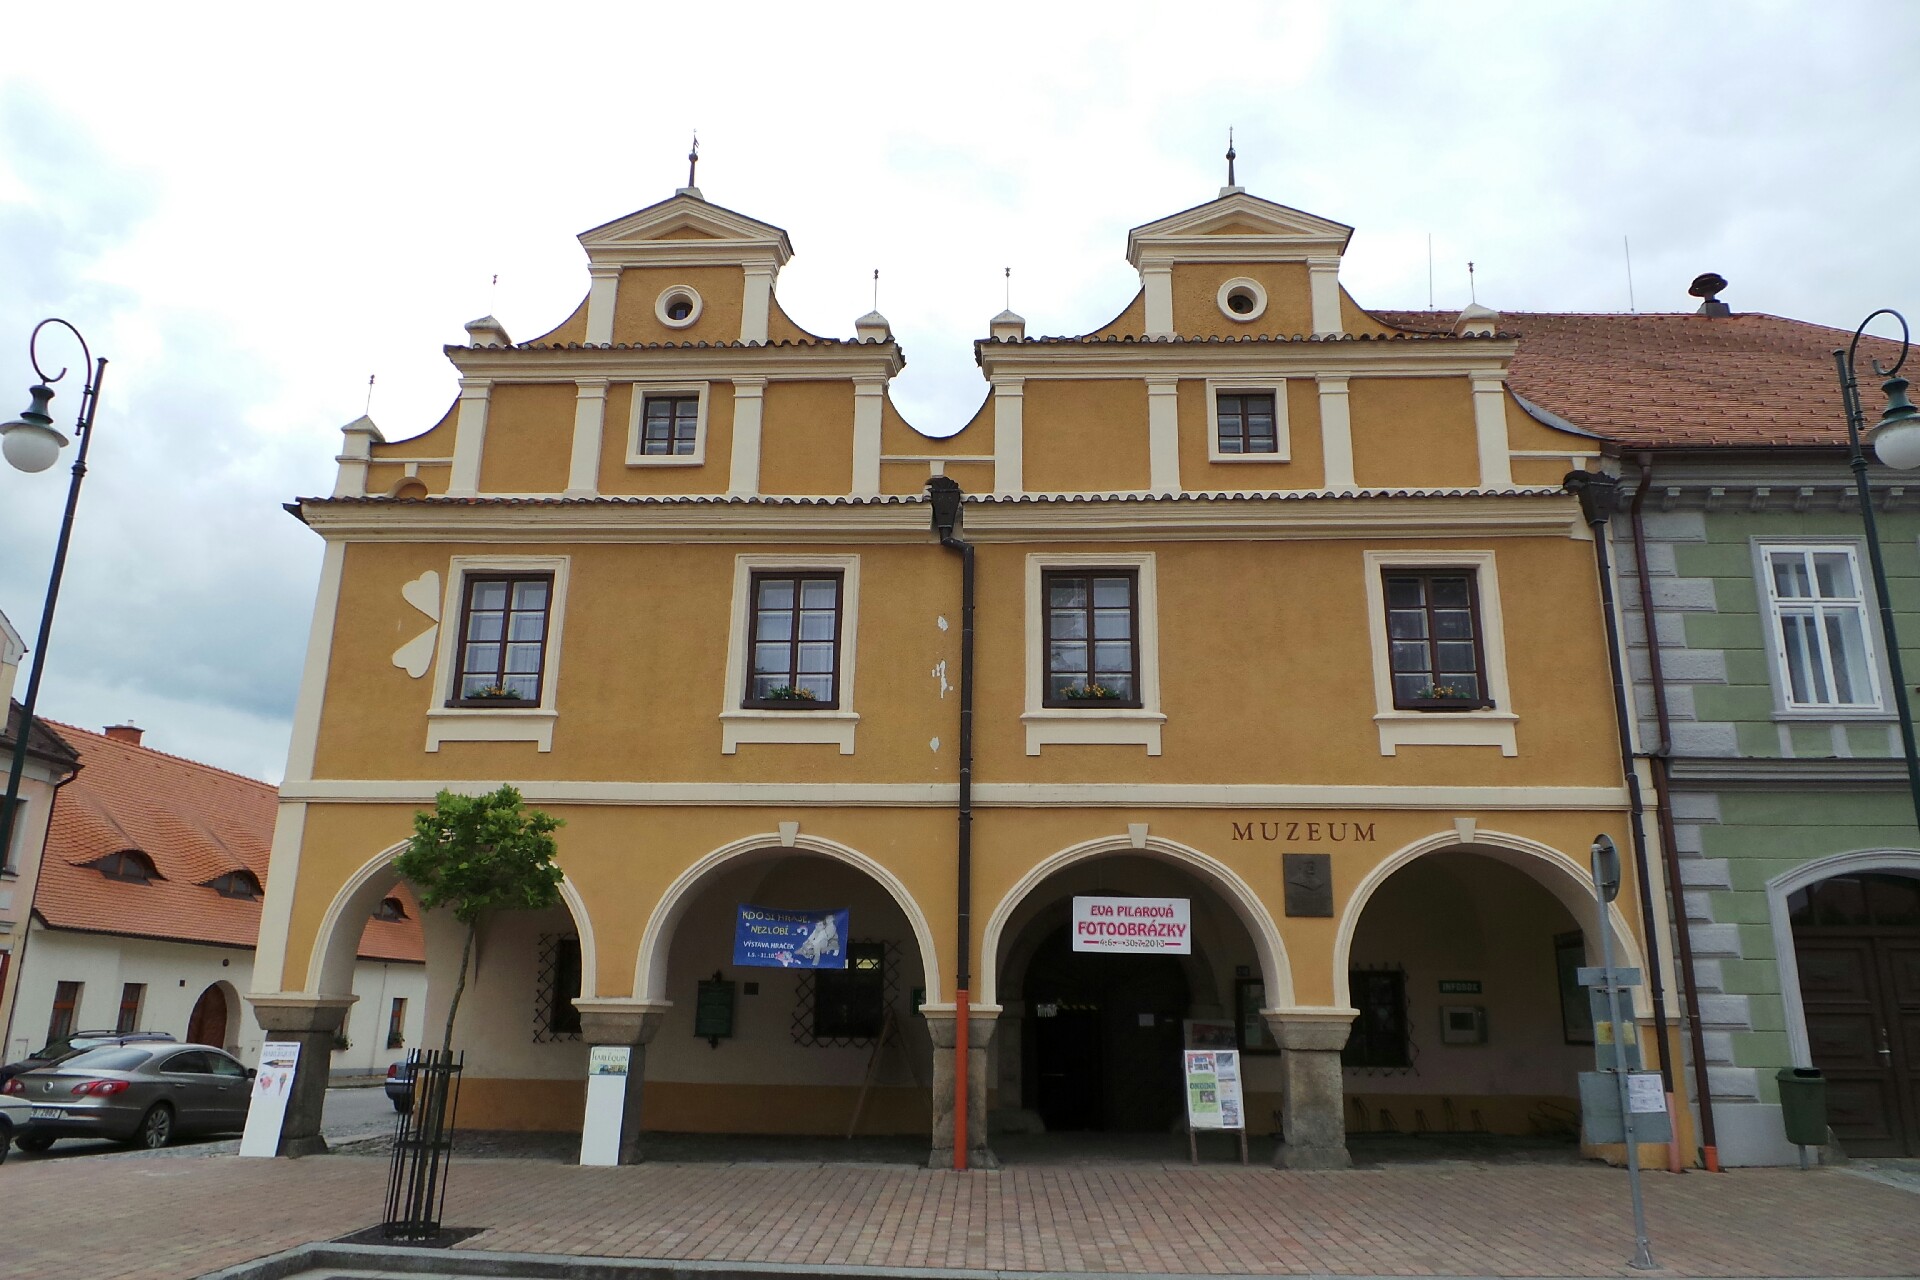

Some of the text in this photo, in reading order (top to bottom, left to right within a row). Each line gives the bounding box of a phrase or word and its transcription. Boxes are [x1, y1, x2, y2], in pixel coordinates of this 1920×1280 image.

[1232, 822, 1376, 842] MUZEUM
[742, 911, 764, 920] KDO
[1091, 904, 1174, 918] EVA PILAROVÁ
[1078, 920, 1186, 938] FOTOOBRÁZKY
[743, 940, 795, 950] VÝSTAVA HRAČEK
